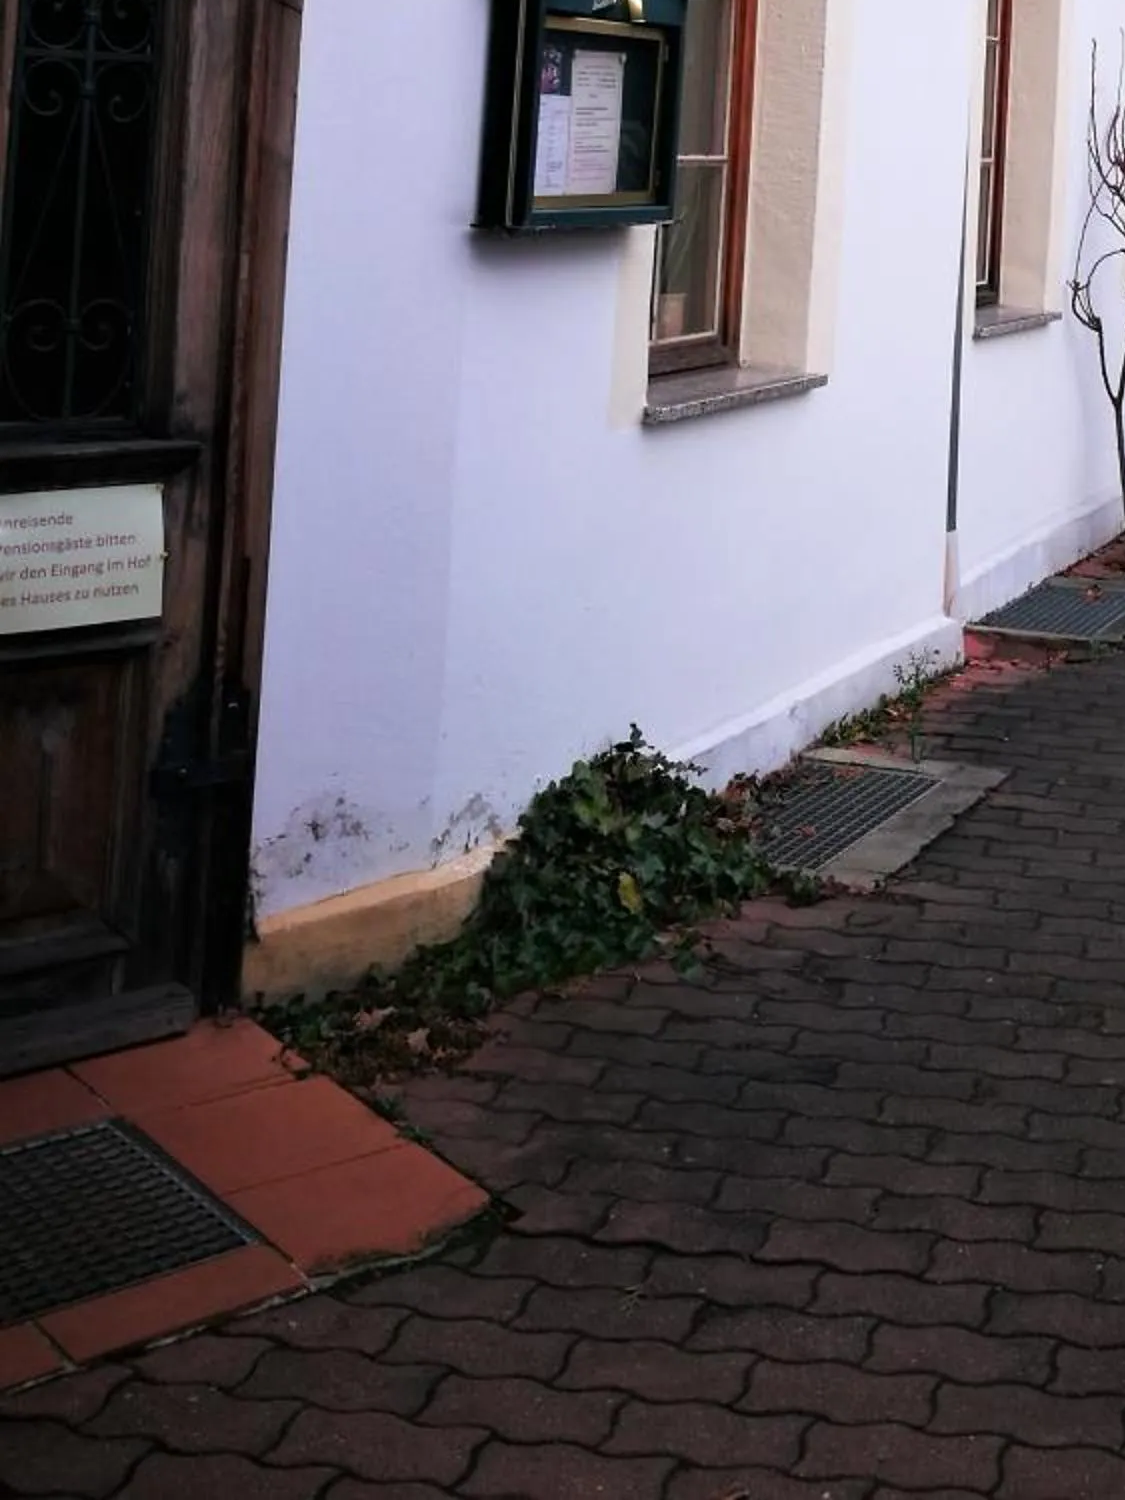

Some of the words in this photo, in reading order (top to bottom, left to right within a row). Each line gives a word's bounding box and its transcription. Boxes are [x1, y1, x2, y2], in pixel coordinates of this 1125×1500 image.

[0, 511, 73, 529] nreisende
[95, 532, 136, 549] bitten
[19, 566, 47, 580] den
[51, 560, 105, 579] Eingang
[107, 558, 124, 572] im
[127, 555, 152, 569] Hof
[21, 588, 71, 606] Hauses
[74, 588, 90, 600] zu
[93, 582, 139, 598] nutzen
